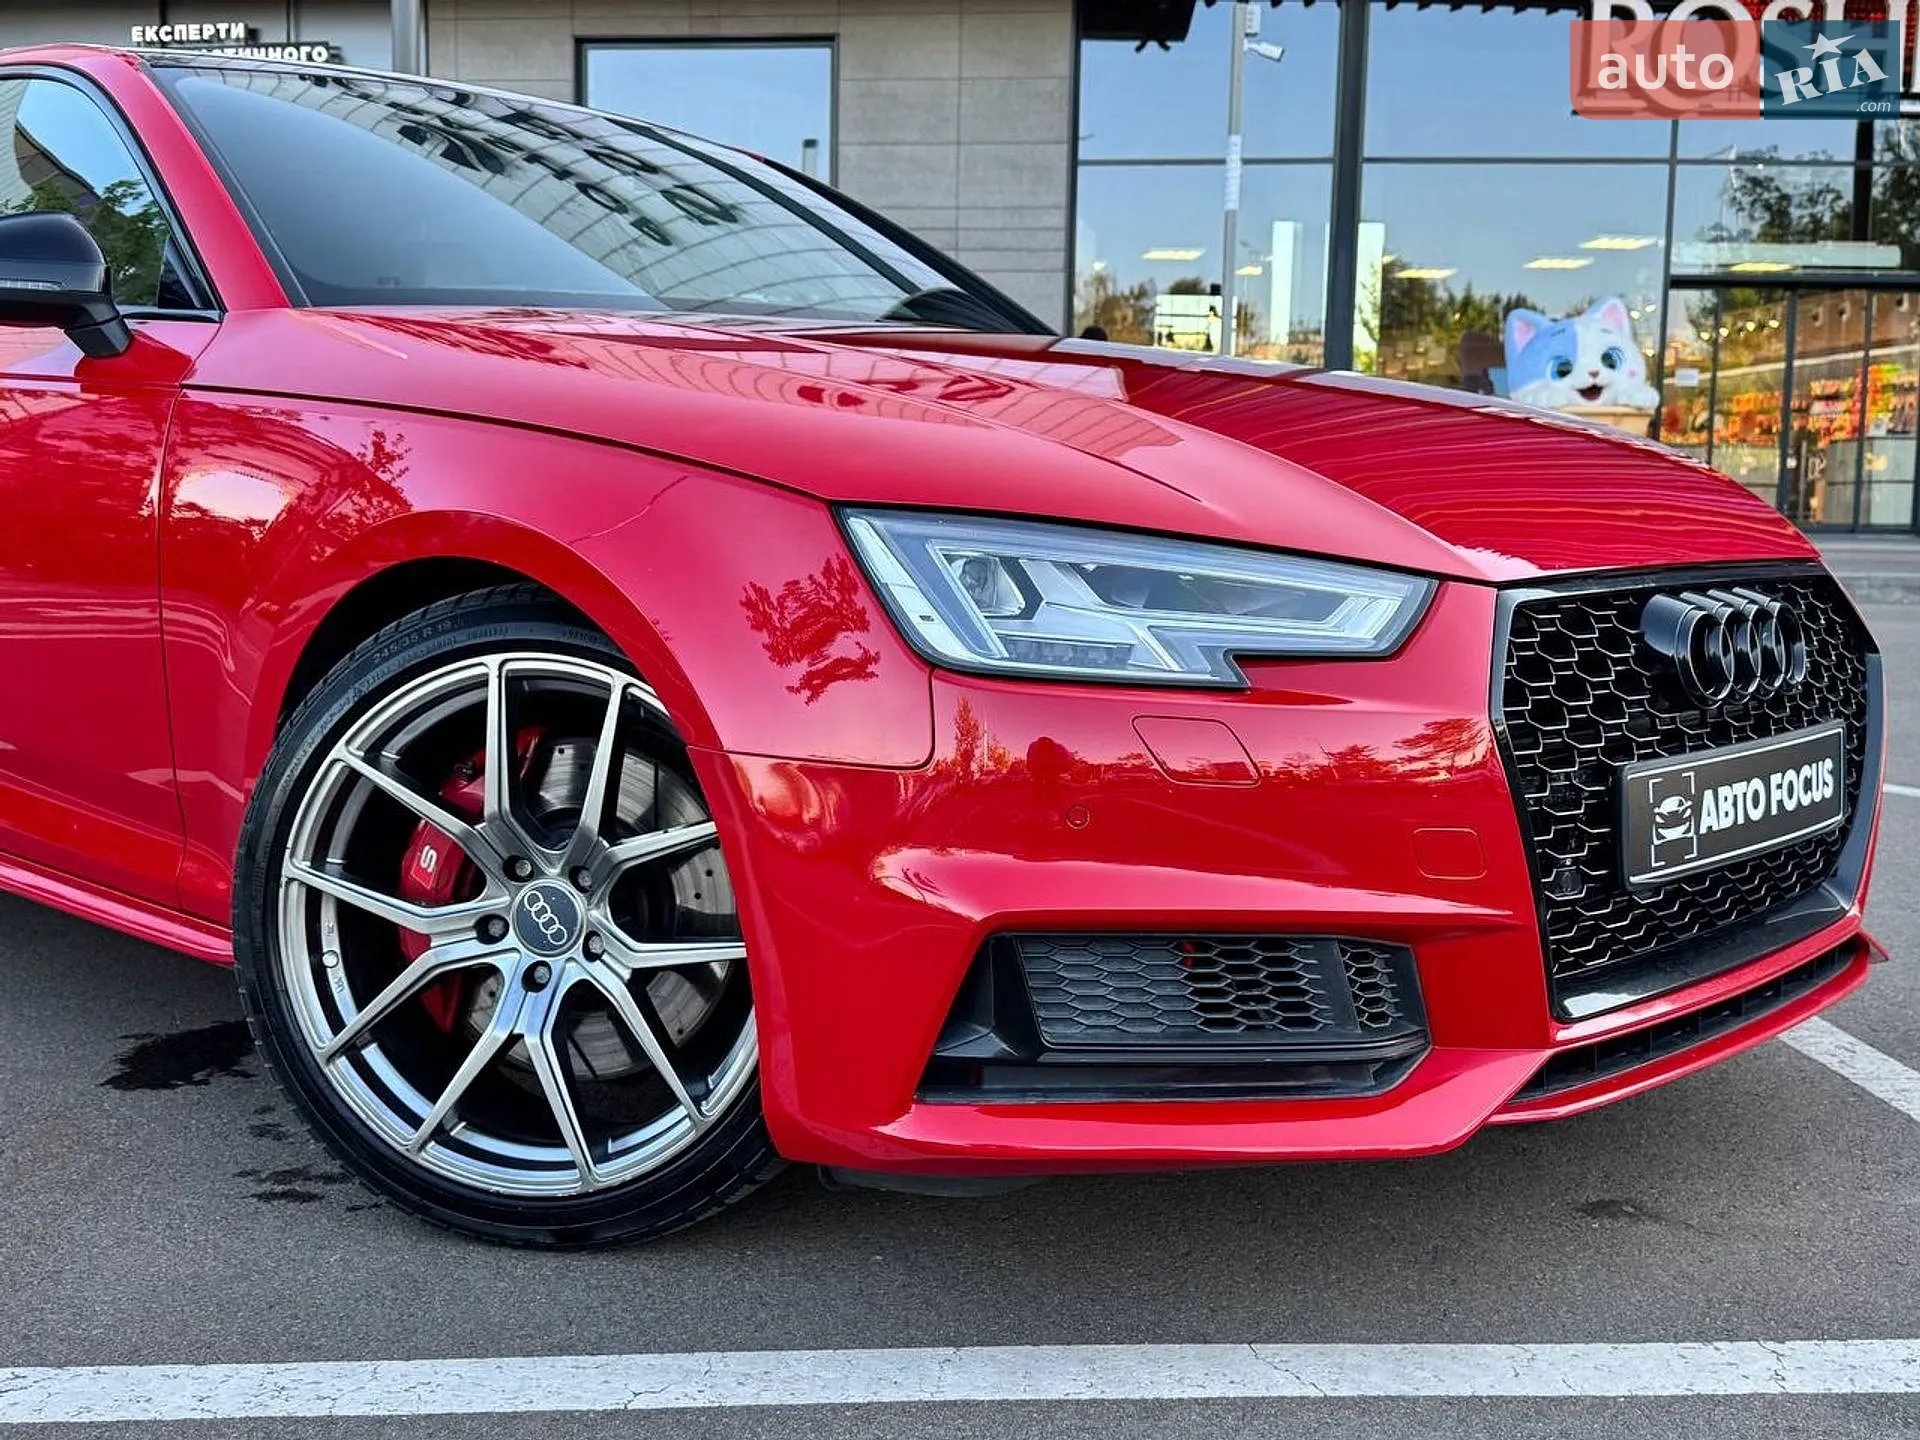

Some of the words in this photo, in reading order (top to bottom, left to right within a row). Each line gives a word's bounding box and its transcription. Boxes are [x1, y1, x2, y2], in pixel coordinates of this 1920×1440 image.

[131, 22, 246, 43] ЕКСПЕРТИ
[1586, 0, 1920, 111] ROSH
[1699, 777, 1767, 835] АВТО
[1770, 757, 1834, 816] FOCUS
[420, 845, 438, 873] S
